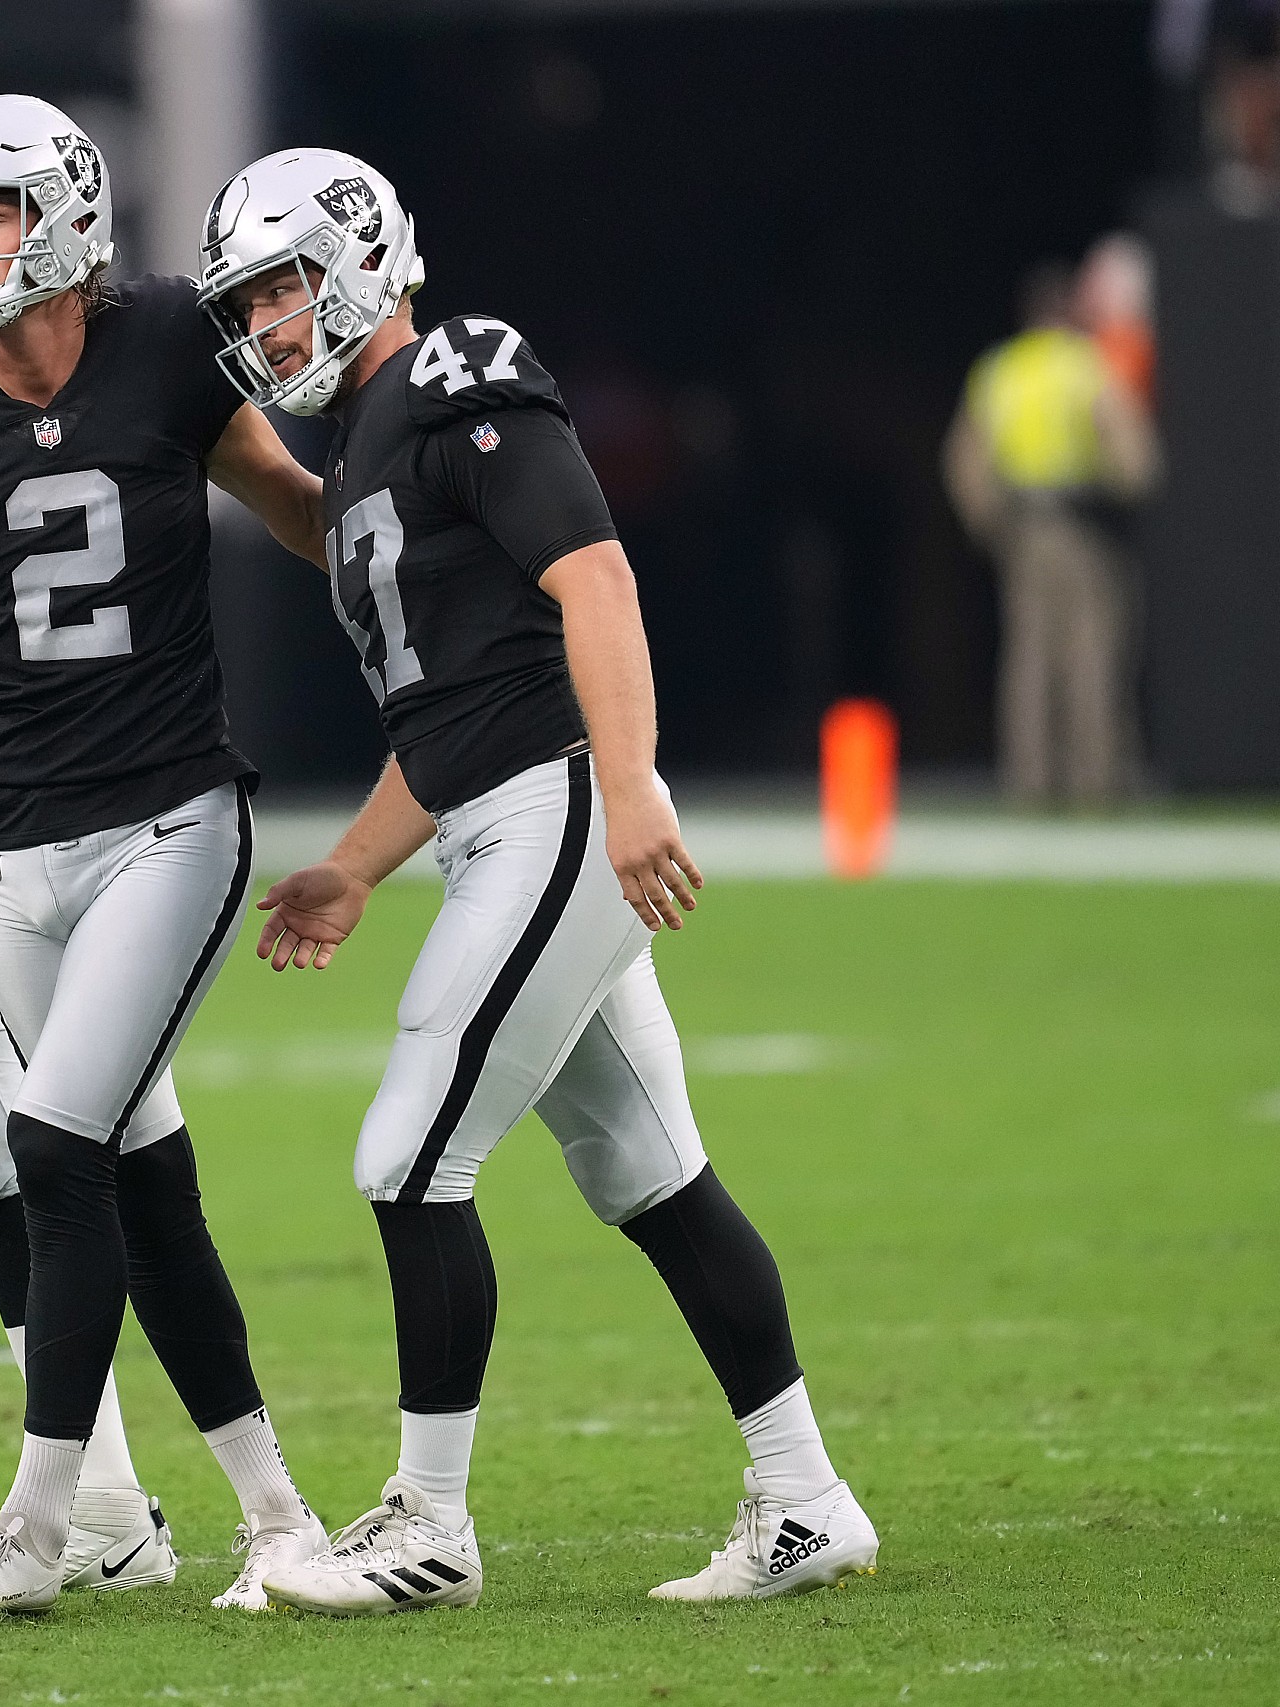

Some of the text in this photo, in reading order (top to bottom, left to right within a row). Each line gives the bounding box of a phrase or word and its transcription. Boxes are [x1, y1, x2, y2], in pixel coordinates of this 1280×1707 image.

[319, 178, 363, 201] RAIDERS
[409, 318, 523, 396] 47
[5, 468, 132, 661] 2
[768, 1533, 831, 1576] adidas
